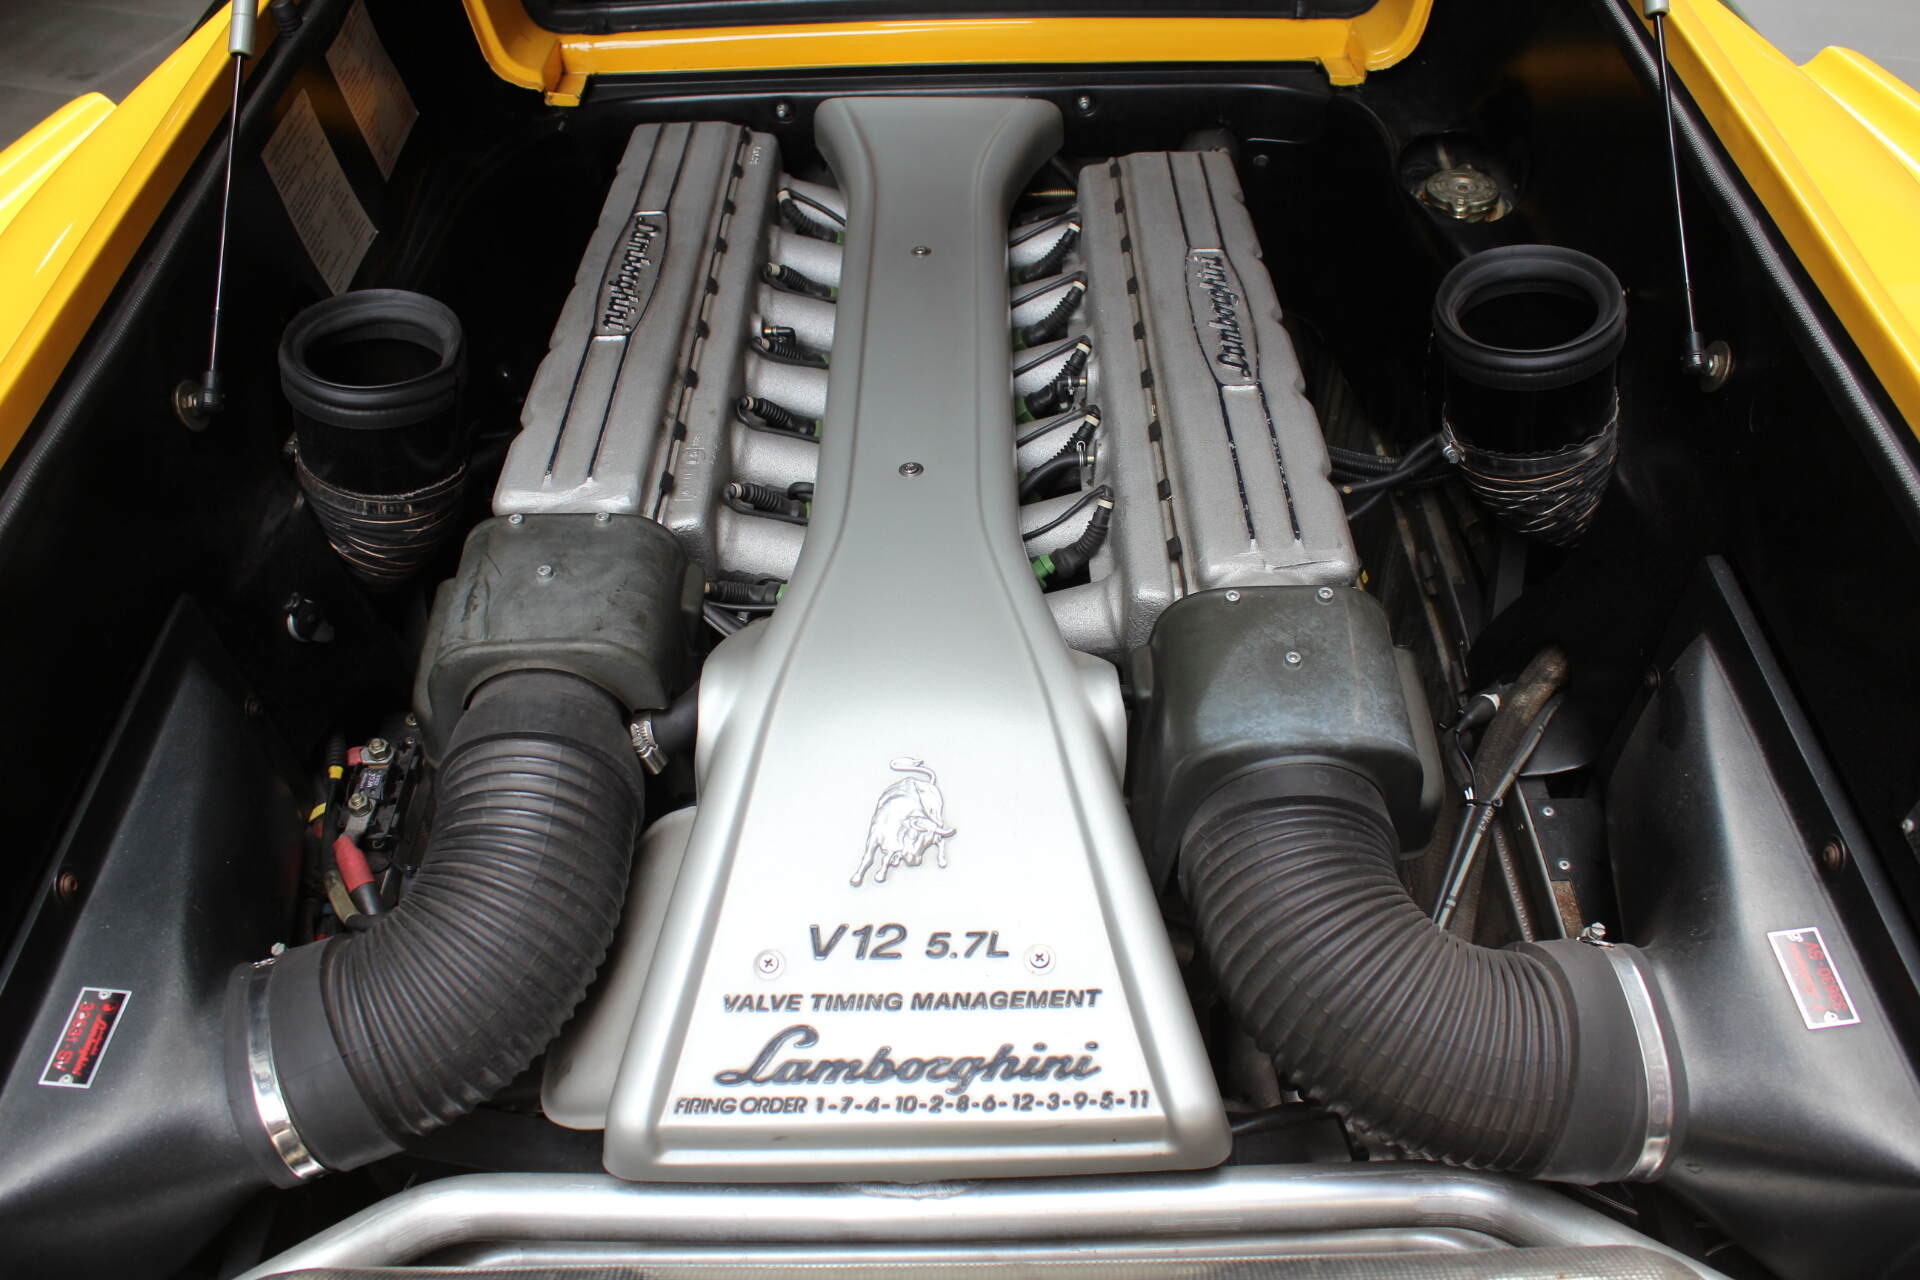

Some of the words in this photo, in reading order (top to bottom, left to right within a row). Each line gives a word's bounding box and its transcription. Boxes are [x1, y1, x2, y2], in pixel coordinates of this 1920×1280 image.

[602, 215, 658, 332] Lamborghini
[1191, 255, 1252, 381] Lamborghini
[809, 923, 908, 961] V12
[925, 930, 1010, 960] 5.7L
[723, 994, 804, 1013] VALVE
[810, 992, 903, 1012] TIMING
[910, 988, 1103, 1011] MANAGEMENT
[713, 1023, 1103, 1096] Lamborghini
[674, 1096, 739, 1116] FIRING
[739, 1096, 808, 1115] ORDER
